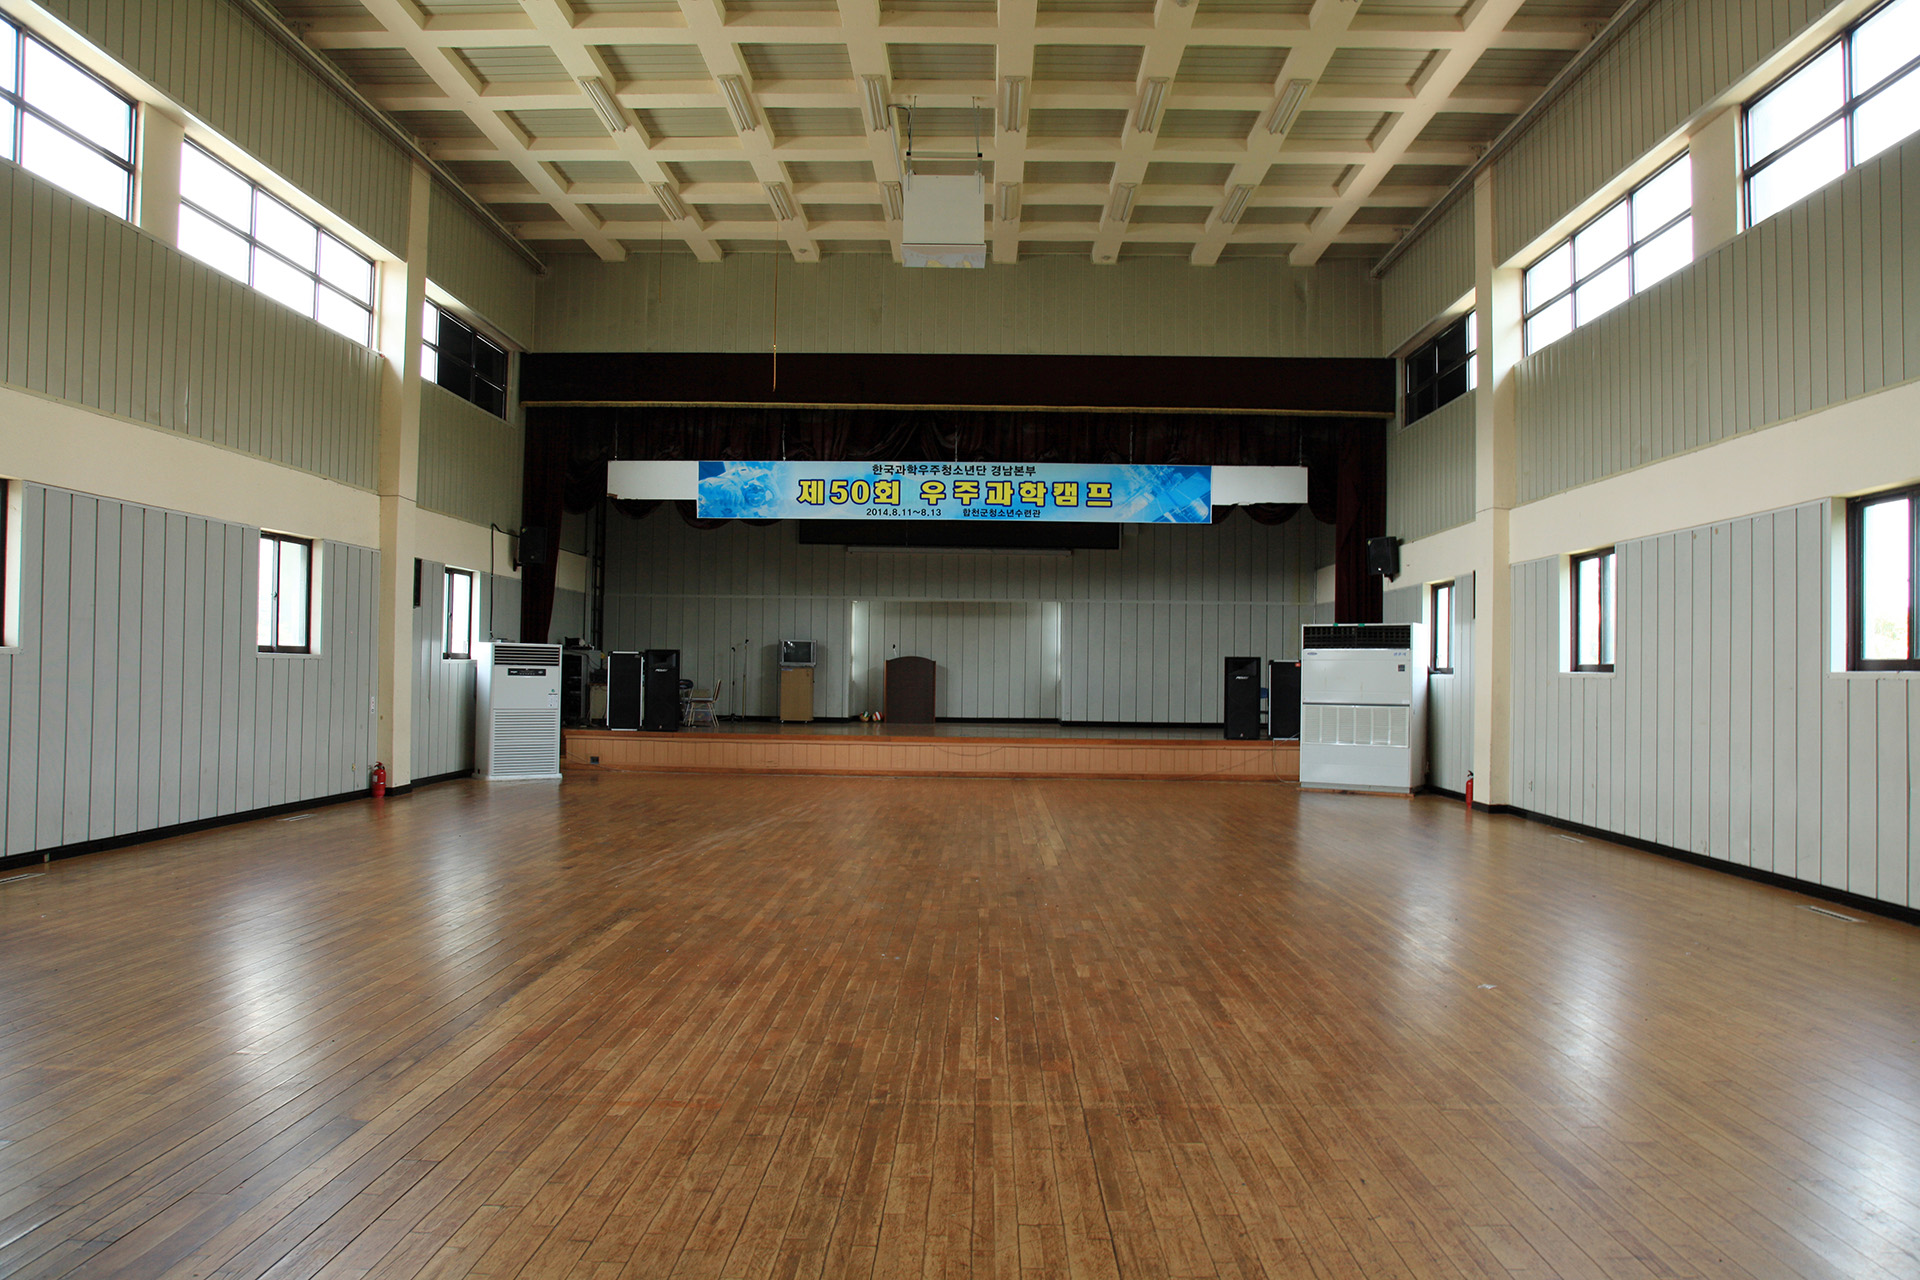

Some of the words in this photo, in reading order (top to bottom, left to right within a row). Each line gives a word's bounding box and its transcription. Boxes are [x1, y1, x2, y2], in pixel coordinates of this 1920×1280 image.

[872, 464, 987, 477] 한국과학우주청소년단
[991, 465, 1037, 477] 경남본부
[797, 479, 900, 505] 제50회
[920, 480, 1113, 508] 우주과학캠프
[866, 508, 942, 517] 2014.8.11~8.13
[962, 508, 1041, 518] 합천군청소년수련관
